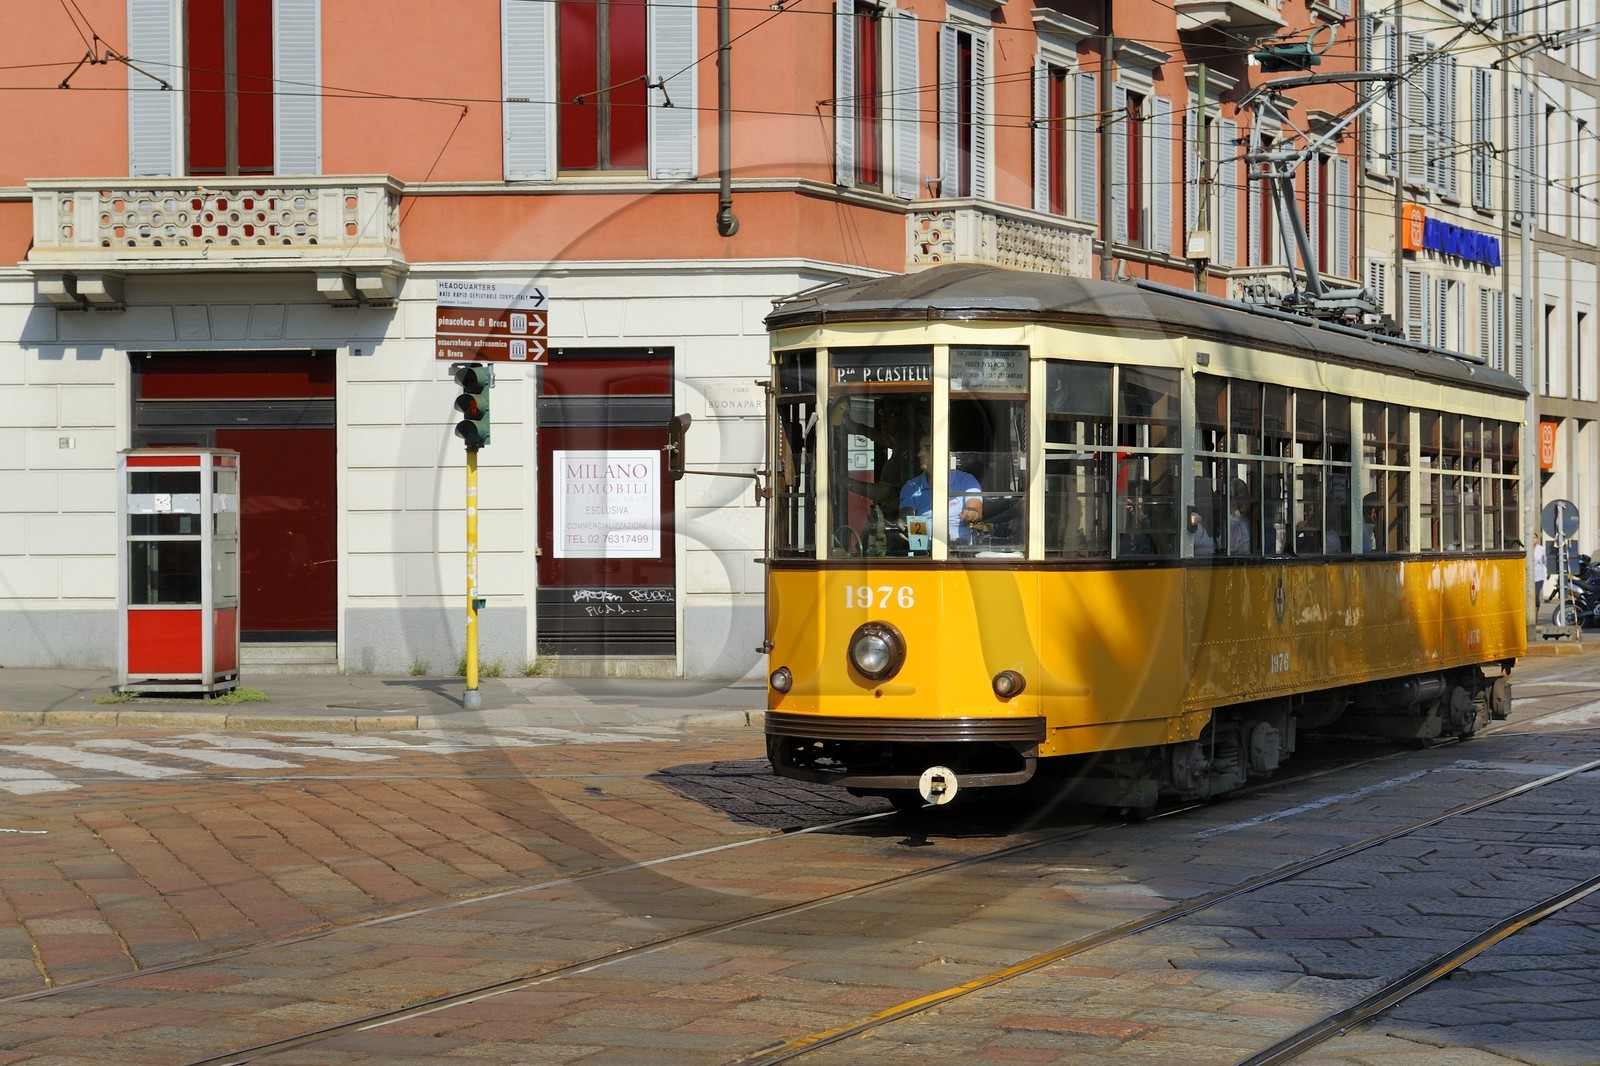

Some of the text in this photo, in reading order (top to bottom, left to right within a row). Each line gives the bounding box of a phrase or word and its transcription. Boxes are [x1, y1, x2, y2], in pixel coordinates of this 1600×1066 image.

[439, 282, 496, 291] HEADQUARTERS
[469, 292, 498, 300] DEPLOYABLE
[438, 316, 508, 328] pinacoteca di Brera
[437, 339, 508, 348] osservatorio astronomico
[447, 350, 464, 358] Brera
[566, 464, 648, 479] MILANO
[566, 483, 648, 494] IMMOBILI
[585, 506, 629, 515] ESCLUSIVA
[567, 522, 648, 530] COMMERCIALIZZAZIONE
[915, 522, 921, 535] 2
[566, 534, 649, 544] TEL 02 76317499
[917, 538, 922, 547] 1
[845, 585, 915, 609] 1976
[1271, 652, 1289, 673] 1976
